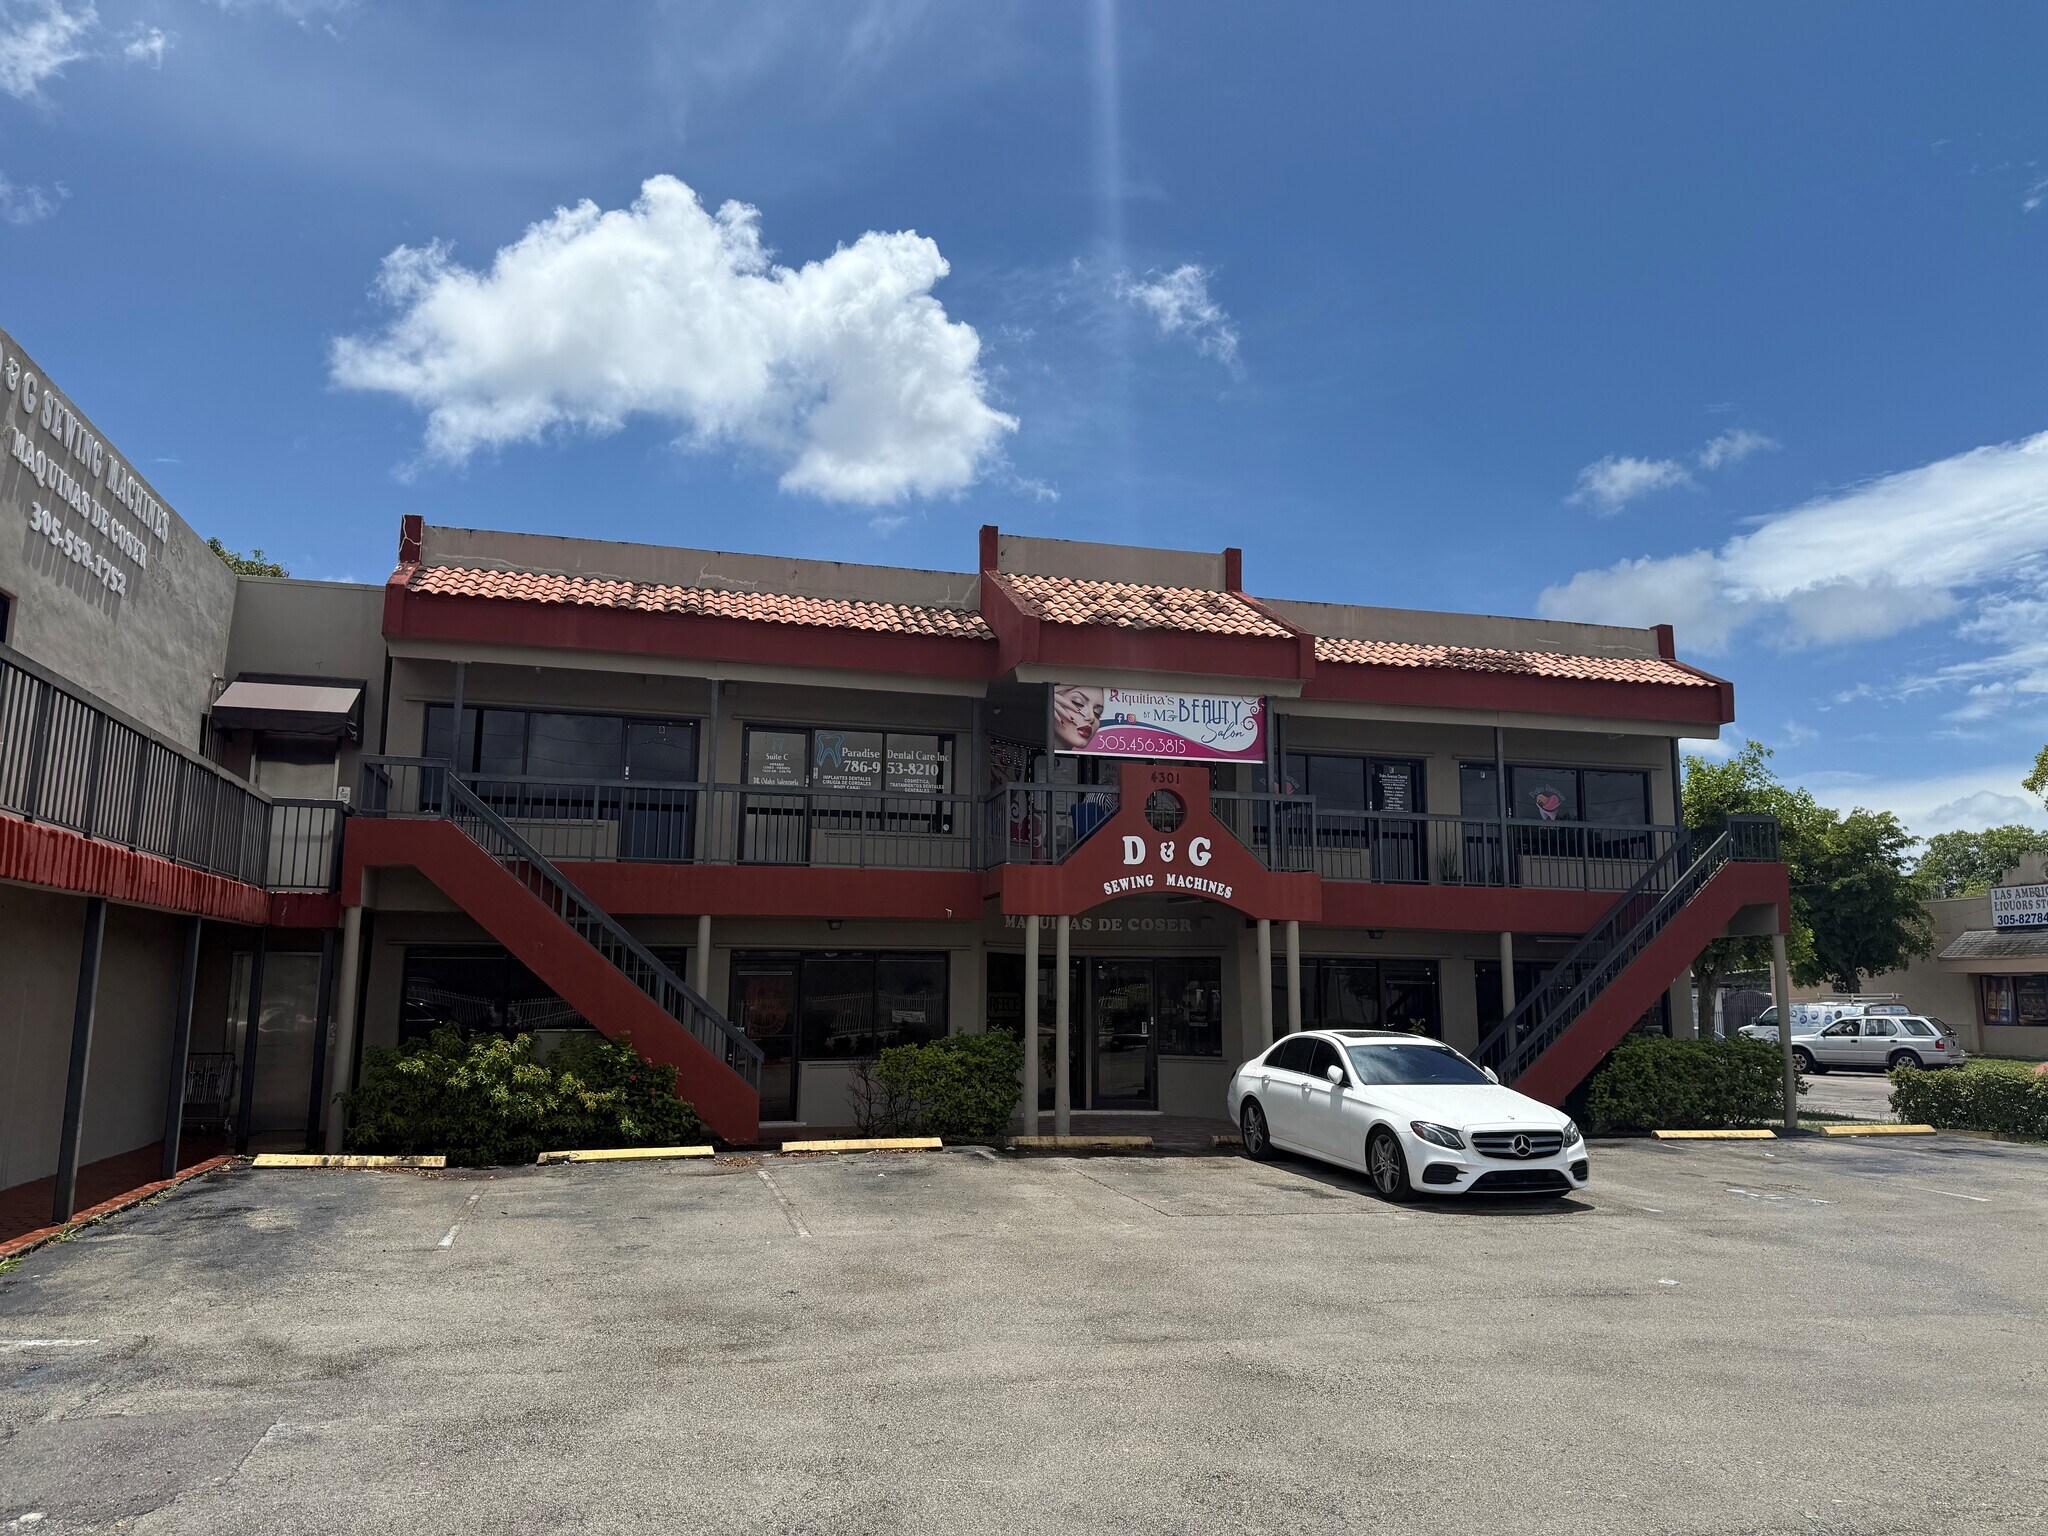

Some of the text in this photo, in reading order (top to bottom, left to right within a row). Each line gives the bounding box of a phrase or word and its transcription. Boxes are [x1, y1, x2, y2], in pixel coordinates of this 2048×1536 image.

[21, 372, 38, 414] G
[40, 390, 103, 478] SEWING
[105, 454, 170, 544] MACHINES
[11, 427, 147, 570] MAQUINAS DE COSER
[29, 502, 127, 597] 305.558.1752
[1109, 688, 1175, 707] Riquitina's
[1179, 698, 1243, 726] BEAUTY
[1201, 717, 1245, 744] Salon
[1097, 734, 1187, 754] 305.456.3815
[765, 752, 789, 761] Suite C
[842, 747, 950, 762] Paradise Dental Care Inc
[1151, 770, 1180, 784] 4301
[1122, 835, 1212, 867] D & G
[1103, 873, 1233, 899] SEWING MACHINES
[1994, 889, 2012, 901] LAS
[1994, 899, 2048, 912] LIQUORS ST
[1004, 915, 1192, 932] MAUIAS DE COSER
